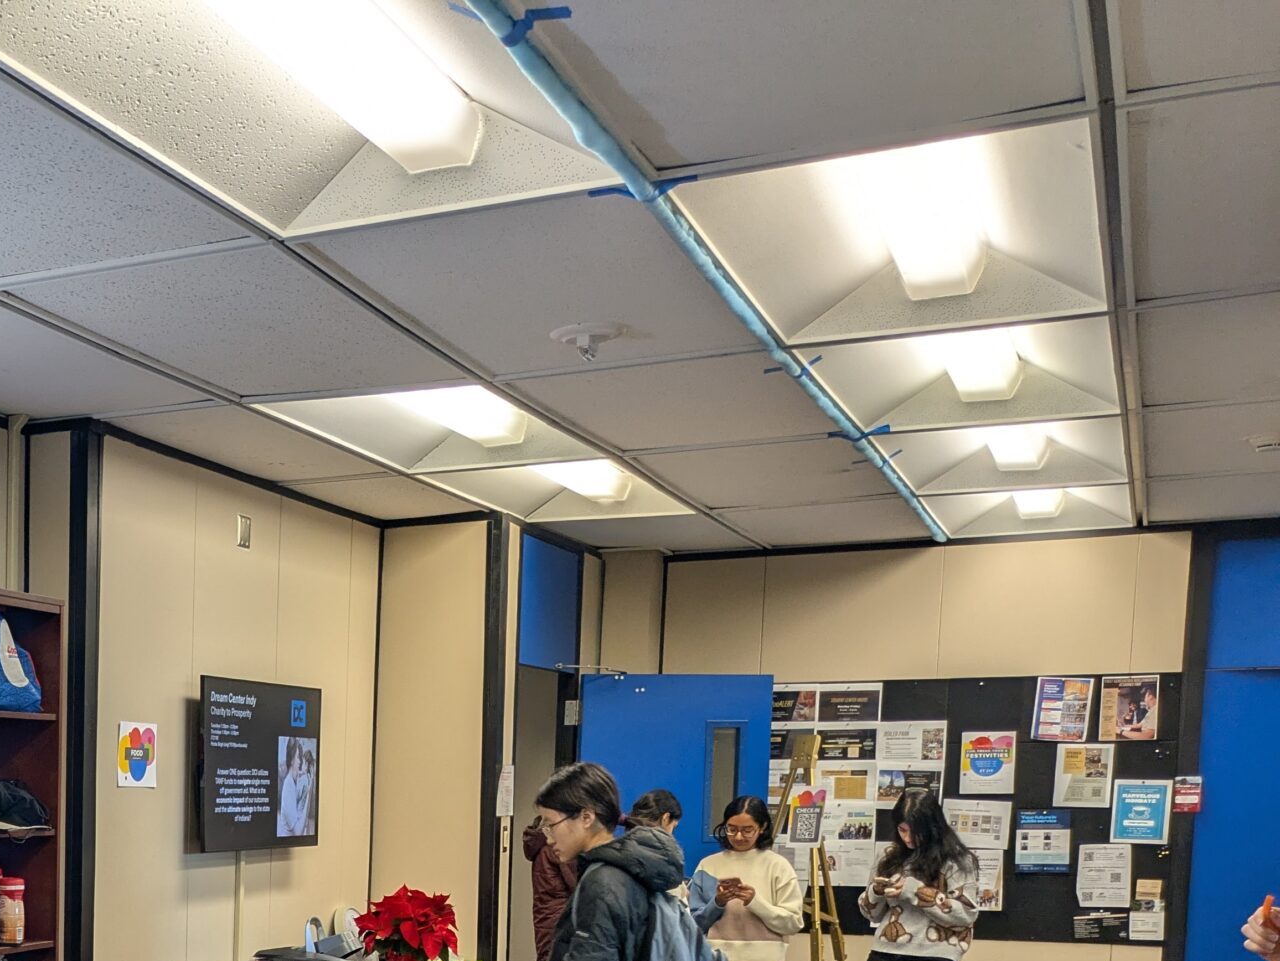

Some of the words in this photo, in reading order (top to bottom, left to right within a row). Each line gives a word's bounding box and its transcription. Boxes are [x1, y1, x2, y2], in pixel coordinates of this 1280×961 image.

[211, 691, 228, 702] Dream
[229, 693, 245, 704] Center
[246, 695, 257, 707] Indy
[211, 706, 226, 718] Charity
[227, 708, 231, 716] to
[231, 708, 252, 720] Prosperity
[131, 749, 143, 757] FOOD
